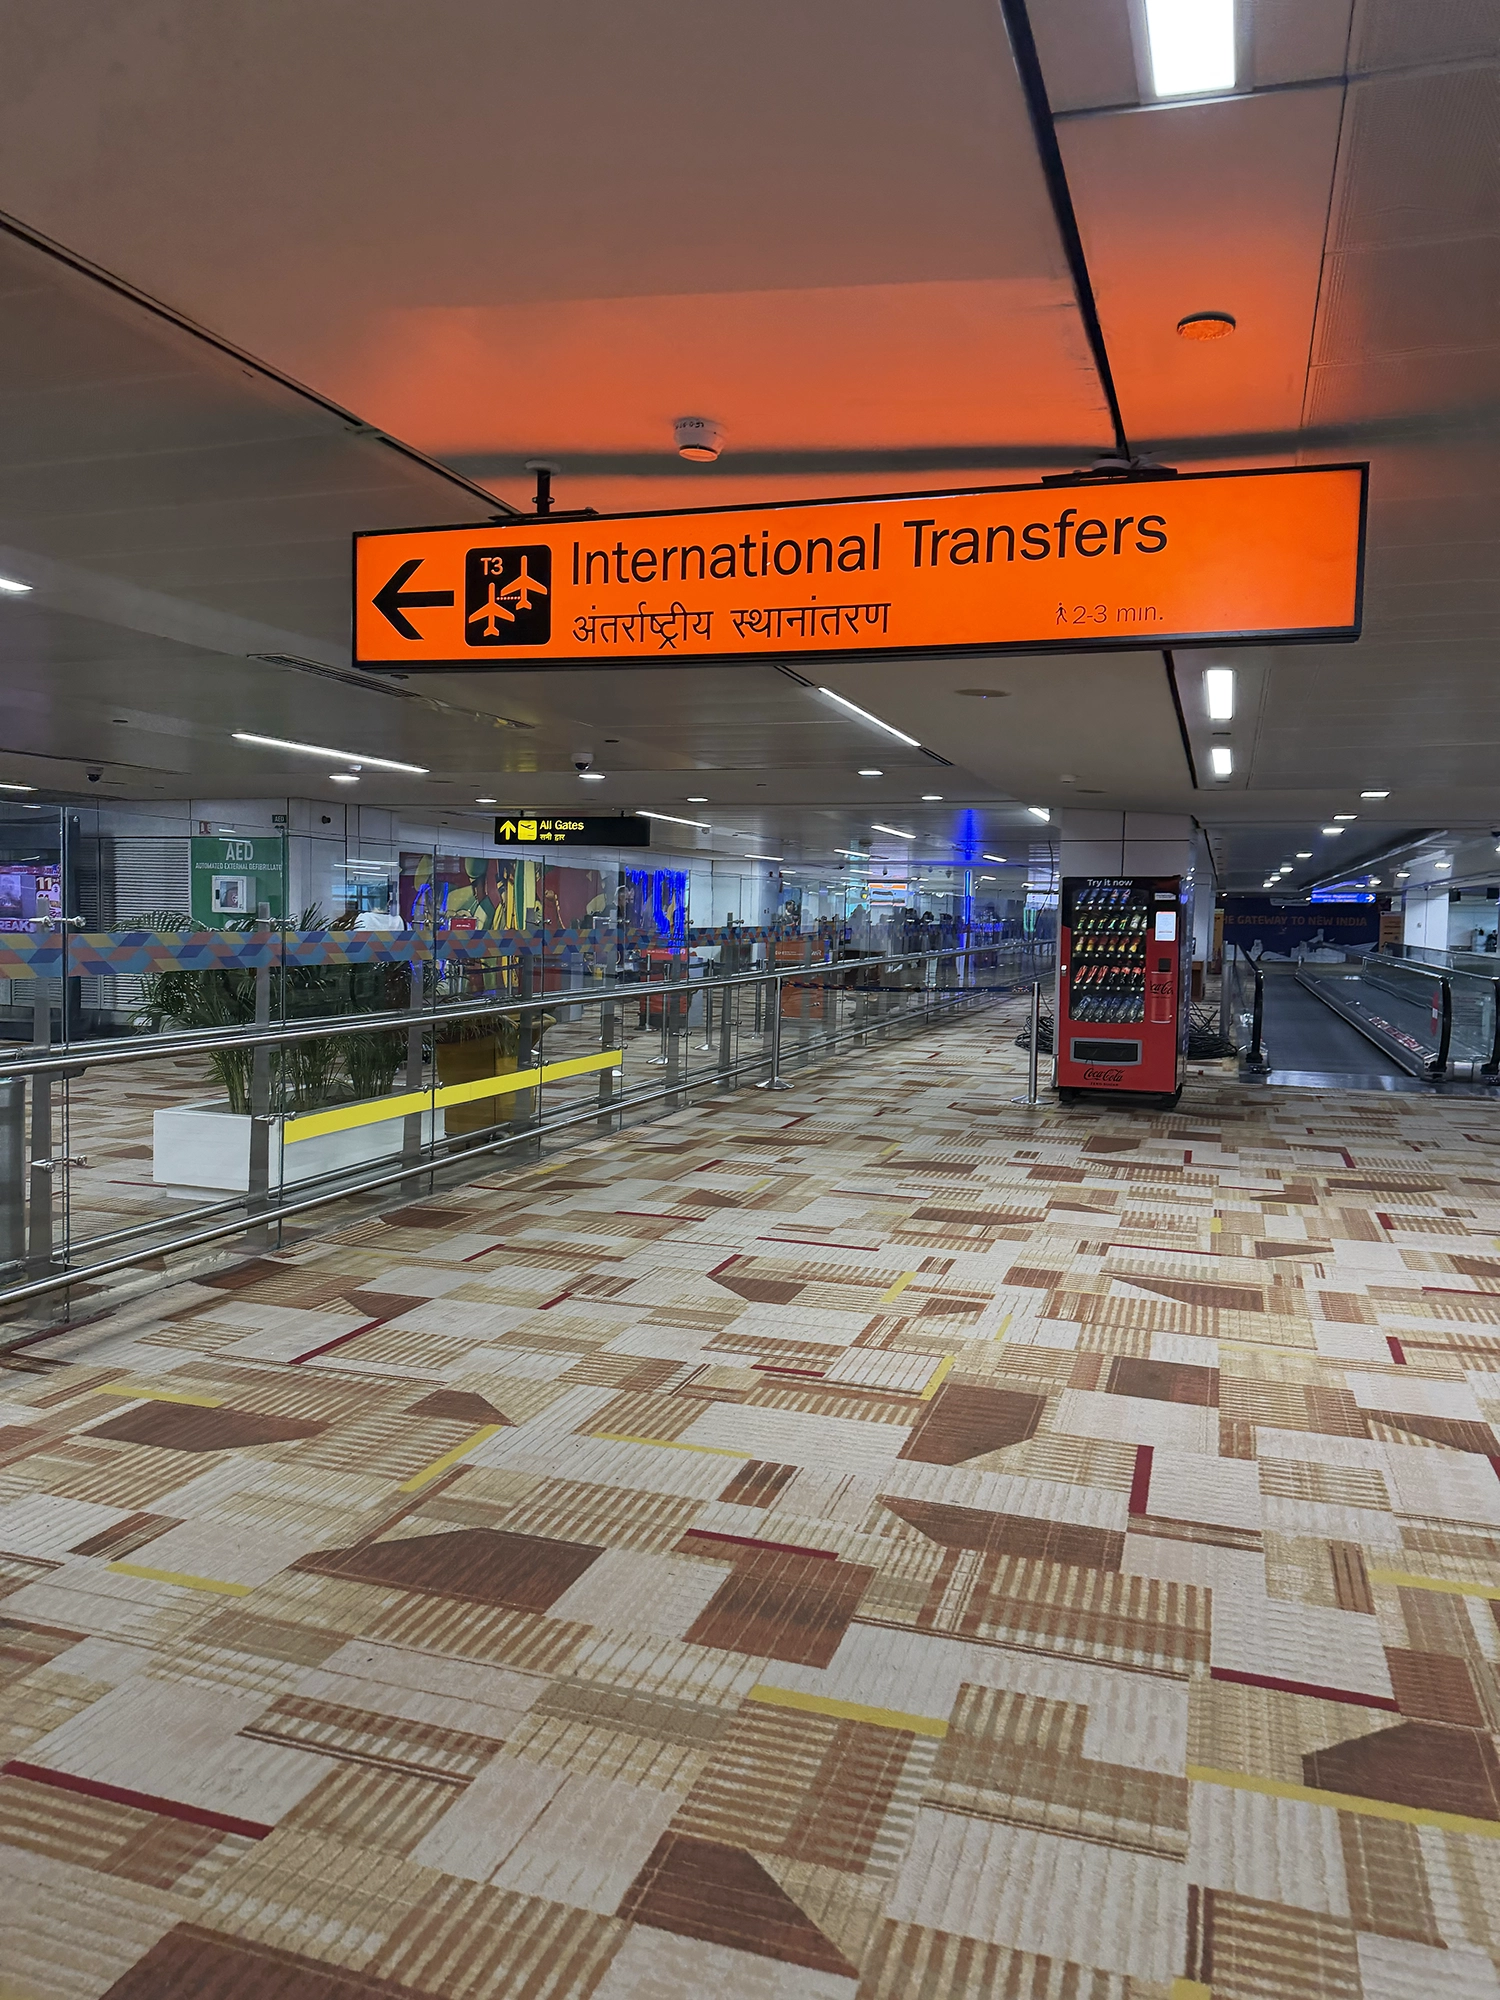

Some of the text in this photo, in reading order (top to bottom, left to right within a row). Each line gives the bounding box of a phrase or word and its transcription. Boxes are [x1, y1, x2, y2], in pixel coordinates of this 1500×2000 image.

[572, 508, 1168, 586] International Transfers
[480, 556, 504, 576] T3
[572, 595, 892, 650] अंतर्राष्ट्रीय स्थानांतरण
[1073, 604, 1164, 624] 2-3 min.
[540, 819, 585, 831] All Gates
[225, 842, 254, 861] AED
[195, 862, 223, 870] AUTOMATED
[248, 863, 282, 871] DEFIBRILLATO
[1087, 879, 1103, 888] Try
[1224, 915, 1368, 926] HE GATEWAY TO NEW INDIA
